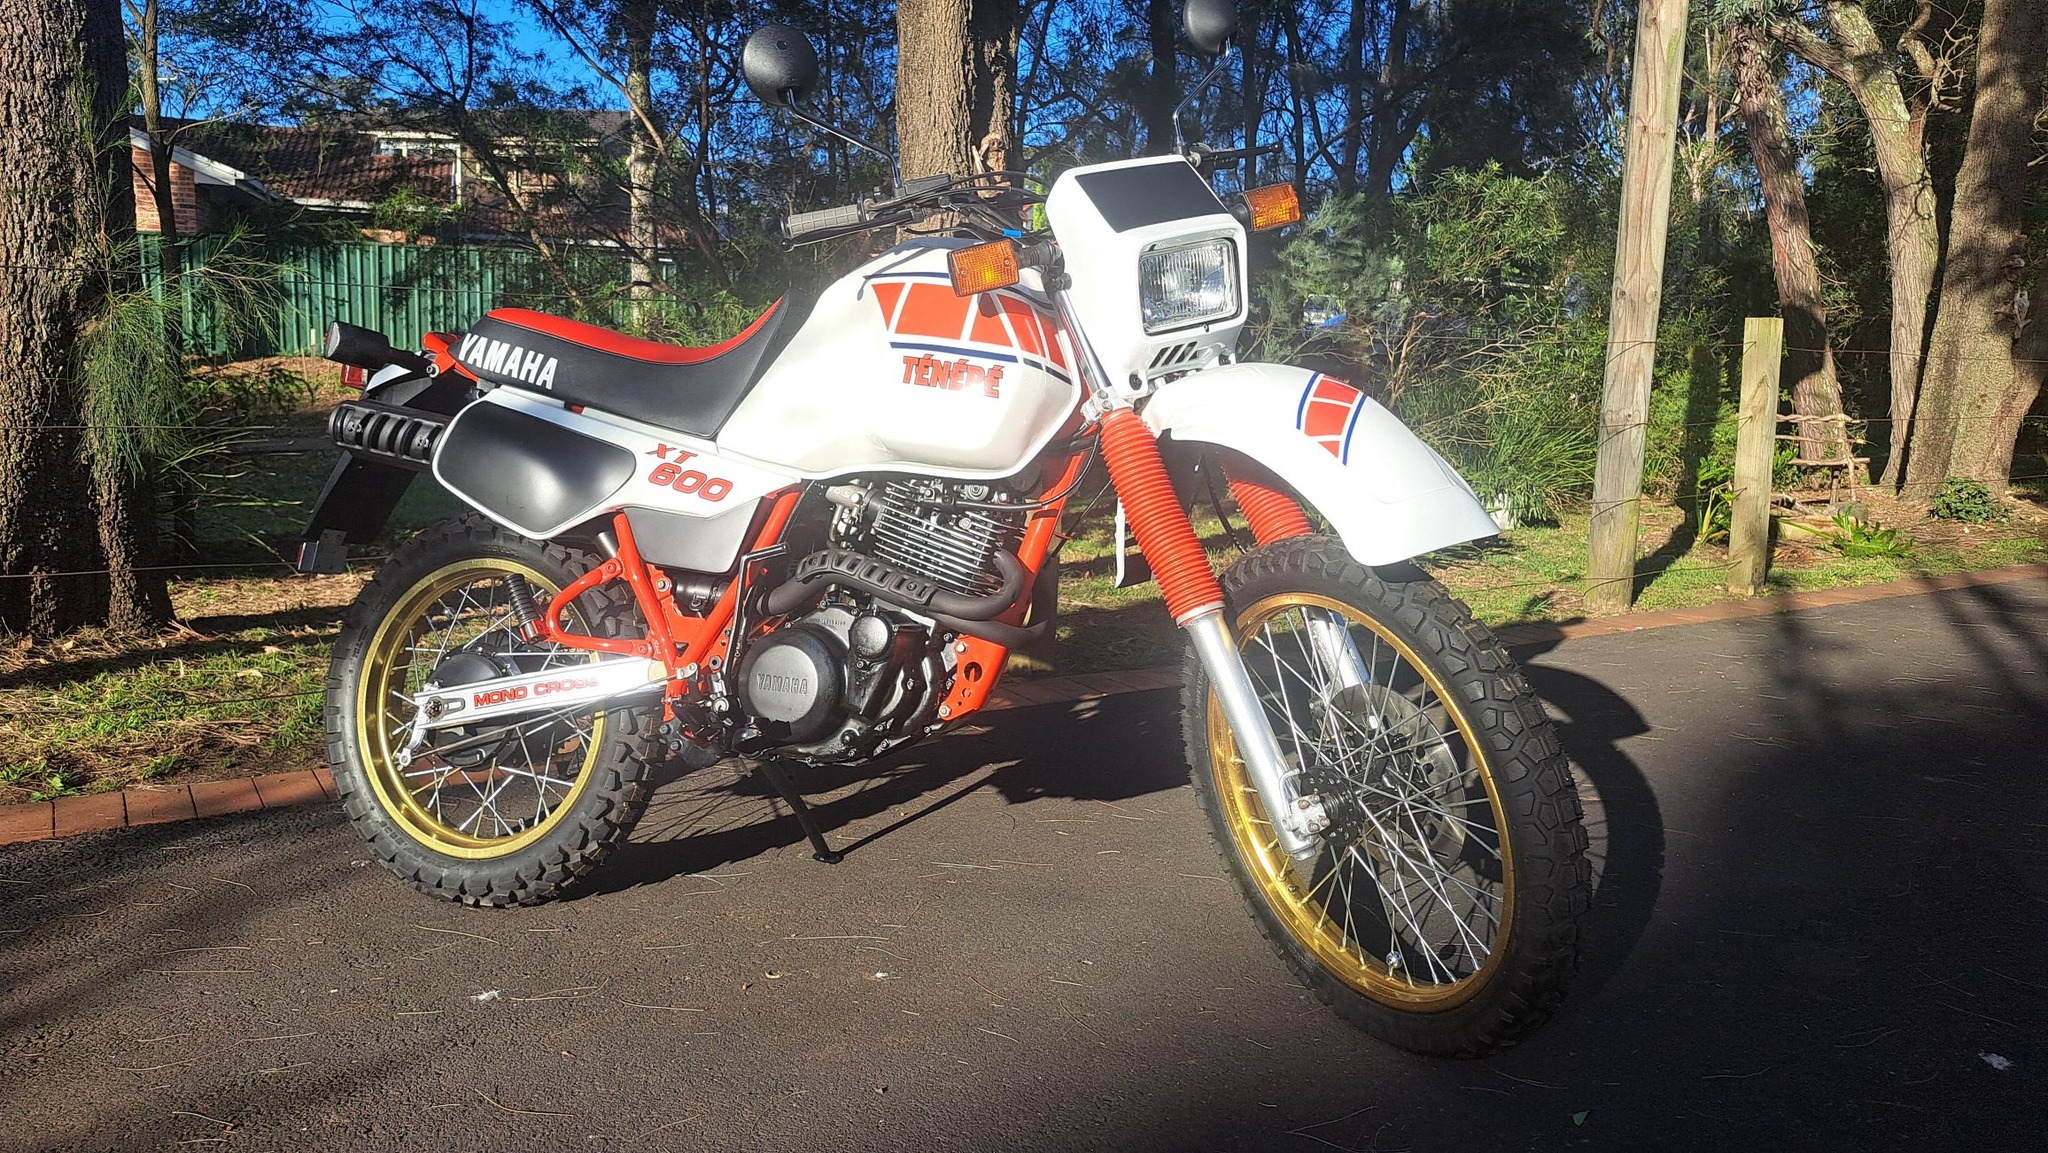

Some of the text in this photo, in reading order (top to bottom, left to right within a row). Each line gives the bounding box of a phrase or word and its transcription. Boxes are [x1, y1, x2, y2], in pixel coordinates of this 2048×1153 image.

[458, 332, 558, 390] YAMAHA
[645, 443, 698, 464] XT
[648, 462, 733, 502] 600
[756, 673, 808, 694] YAMAHA
[473, 686, 528, 707] MONO
